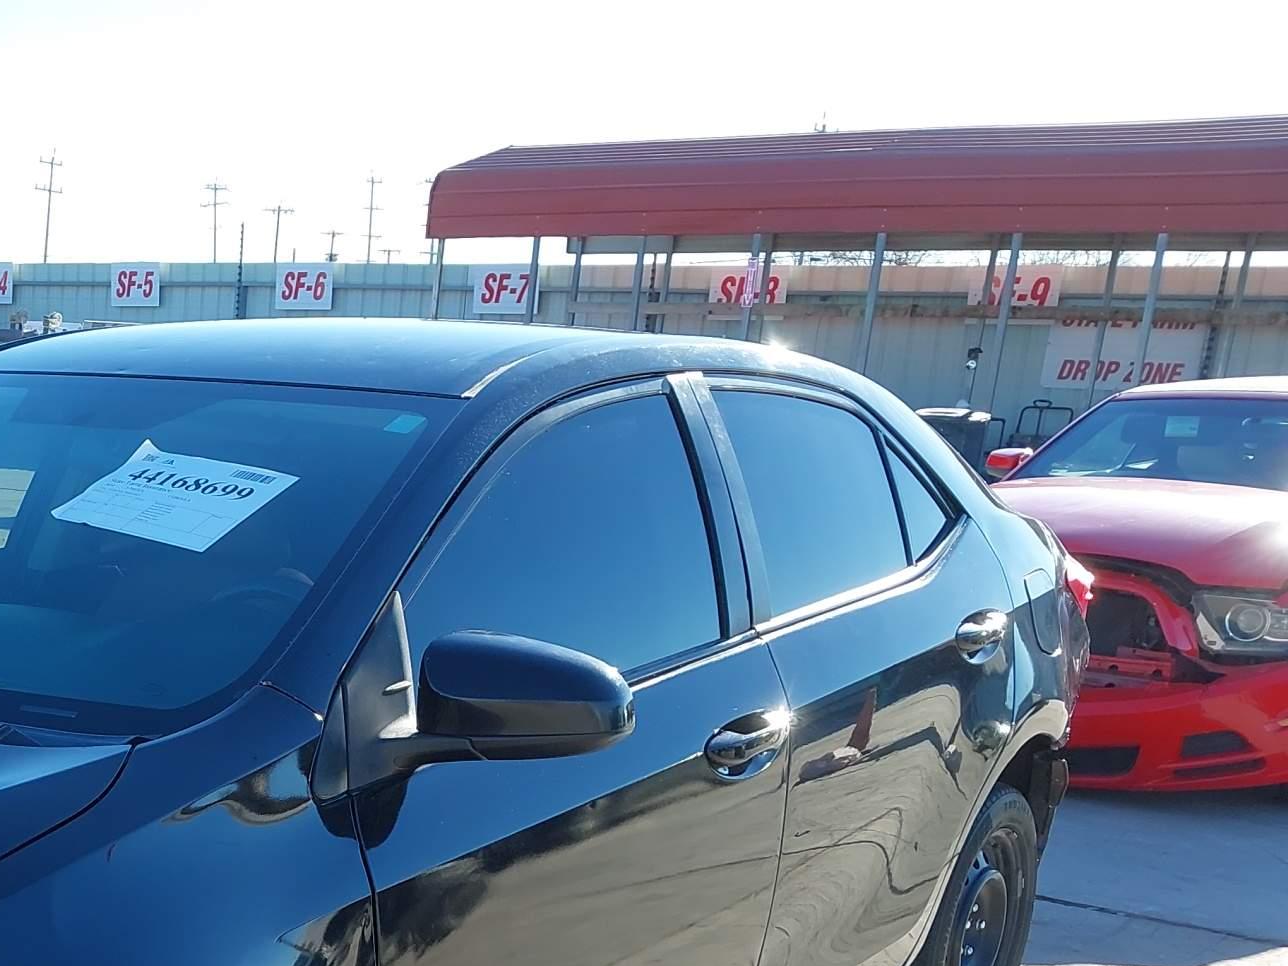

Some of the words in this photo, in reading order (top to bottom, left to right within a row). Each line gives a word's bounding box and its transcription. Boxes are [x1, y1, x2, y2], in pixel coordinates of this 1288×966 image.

[116, 270, 155, 298] SF-5
[281, 271, 328, 301] SF-6
[480, 272, 531, 304] SF-7
[1056, 359, 1121, 381] DROP
[127, 468, 256, 501] 44168699
